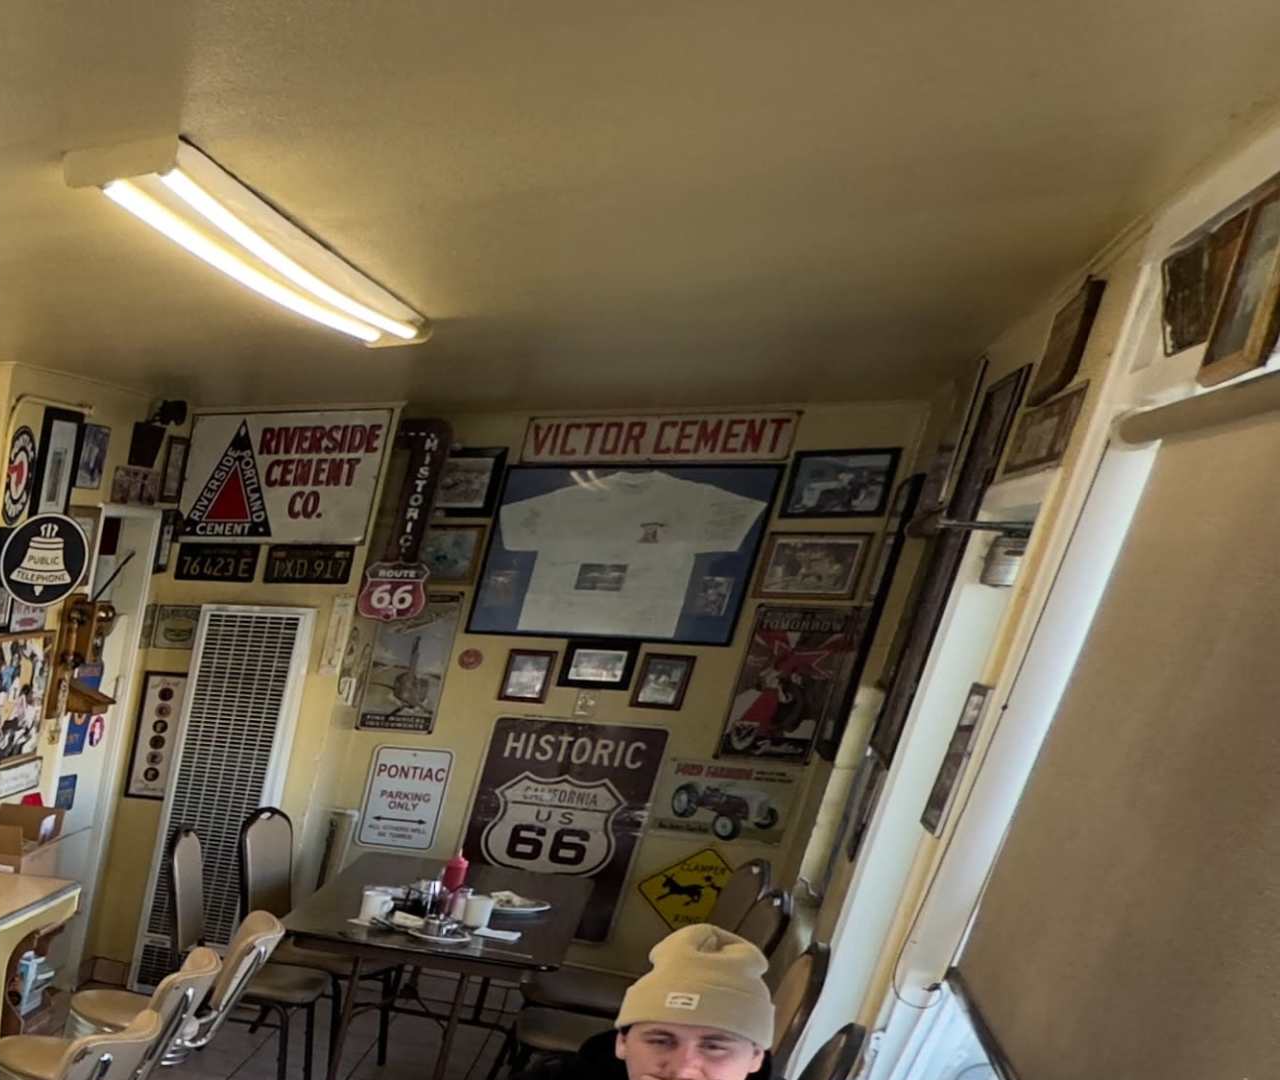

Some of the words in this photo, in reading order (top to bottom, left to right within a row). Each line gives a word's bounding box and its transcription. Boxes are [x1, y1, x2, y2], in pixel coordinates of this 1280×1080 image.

[258, 424, 383, 456] RIVERSIDE
[532, 420, 647, 457] VICTOR
[652, 418, 792, 455] CEMENT
[191, 446, 240, 521] RIVERSIDE
[239, 448, 265, 522] PORTLAND
[264, 457, 362, 488] CEMENT
[287, 490, 323, 520] CO.
[399, 437, 438, 547] HISTORIC
[195, 522, 251, 536] CEMENT
[27, 554, 61, 566] PUBLIC
[378, 569, 417, 579] ROUTE
[15, 570, 66, 583] TELEPHONE
[370, 584, 414, 610] 66
[503, 731, 647, 769] HISTORIC
[377, 763, 446, 782] PONTIAC
[380, 789, 431, 804] PARKING
[388, 800, 419, 812] ONLY
[505, 823, 590, 866] 66
